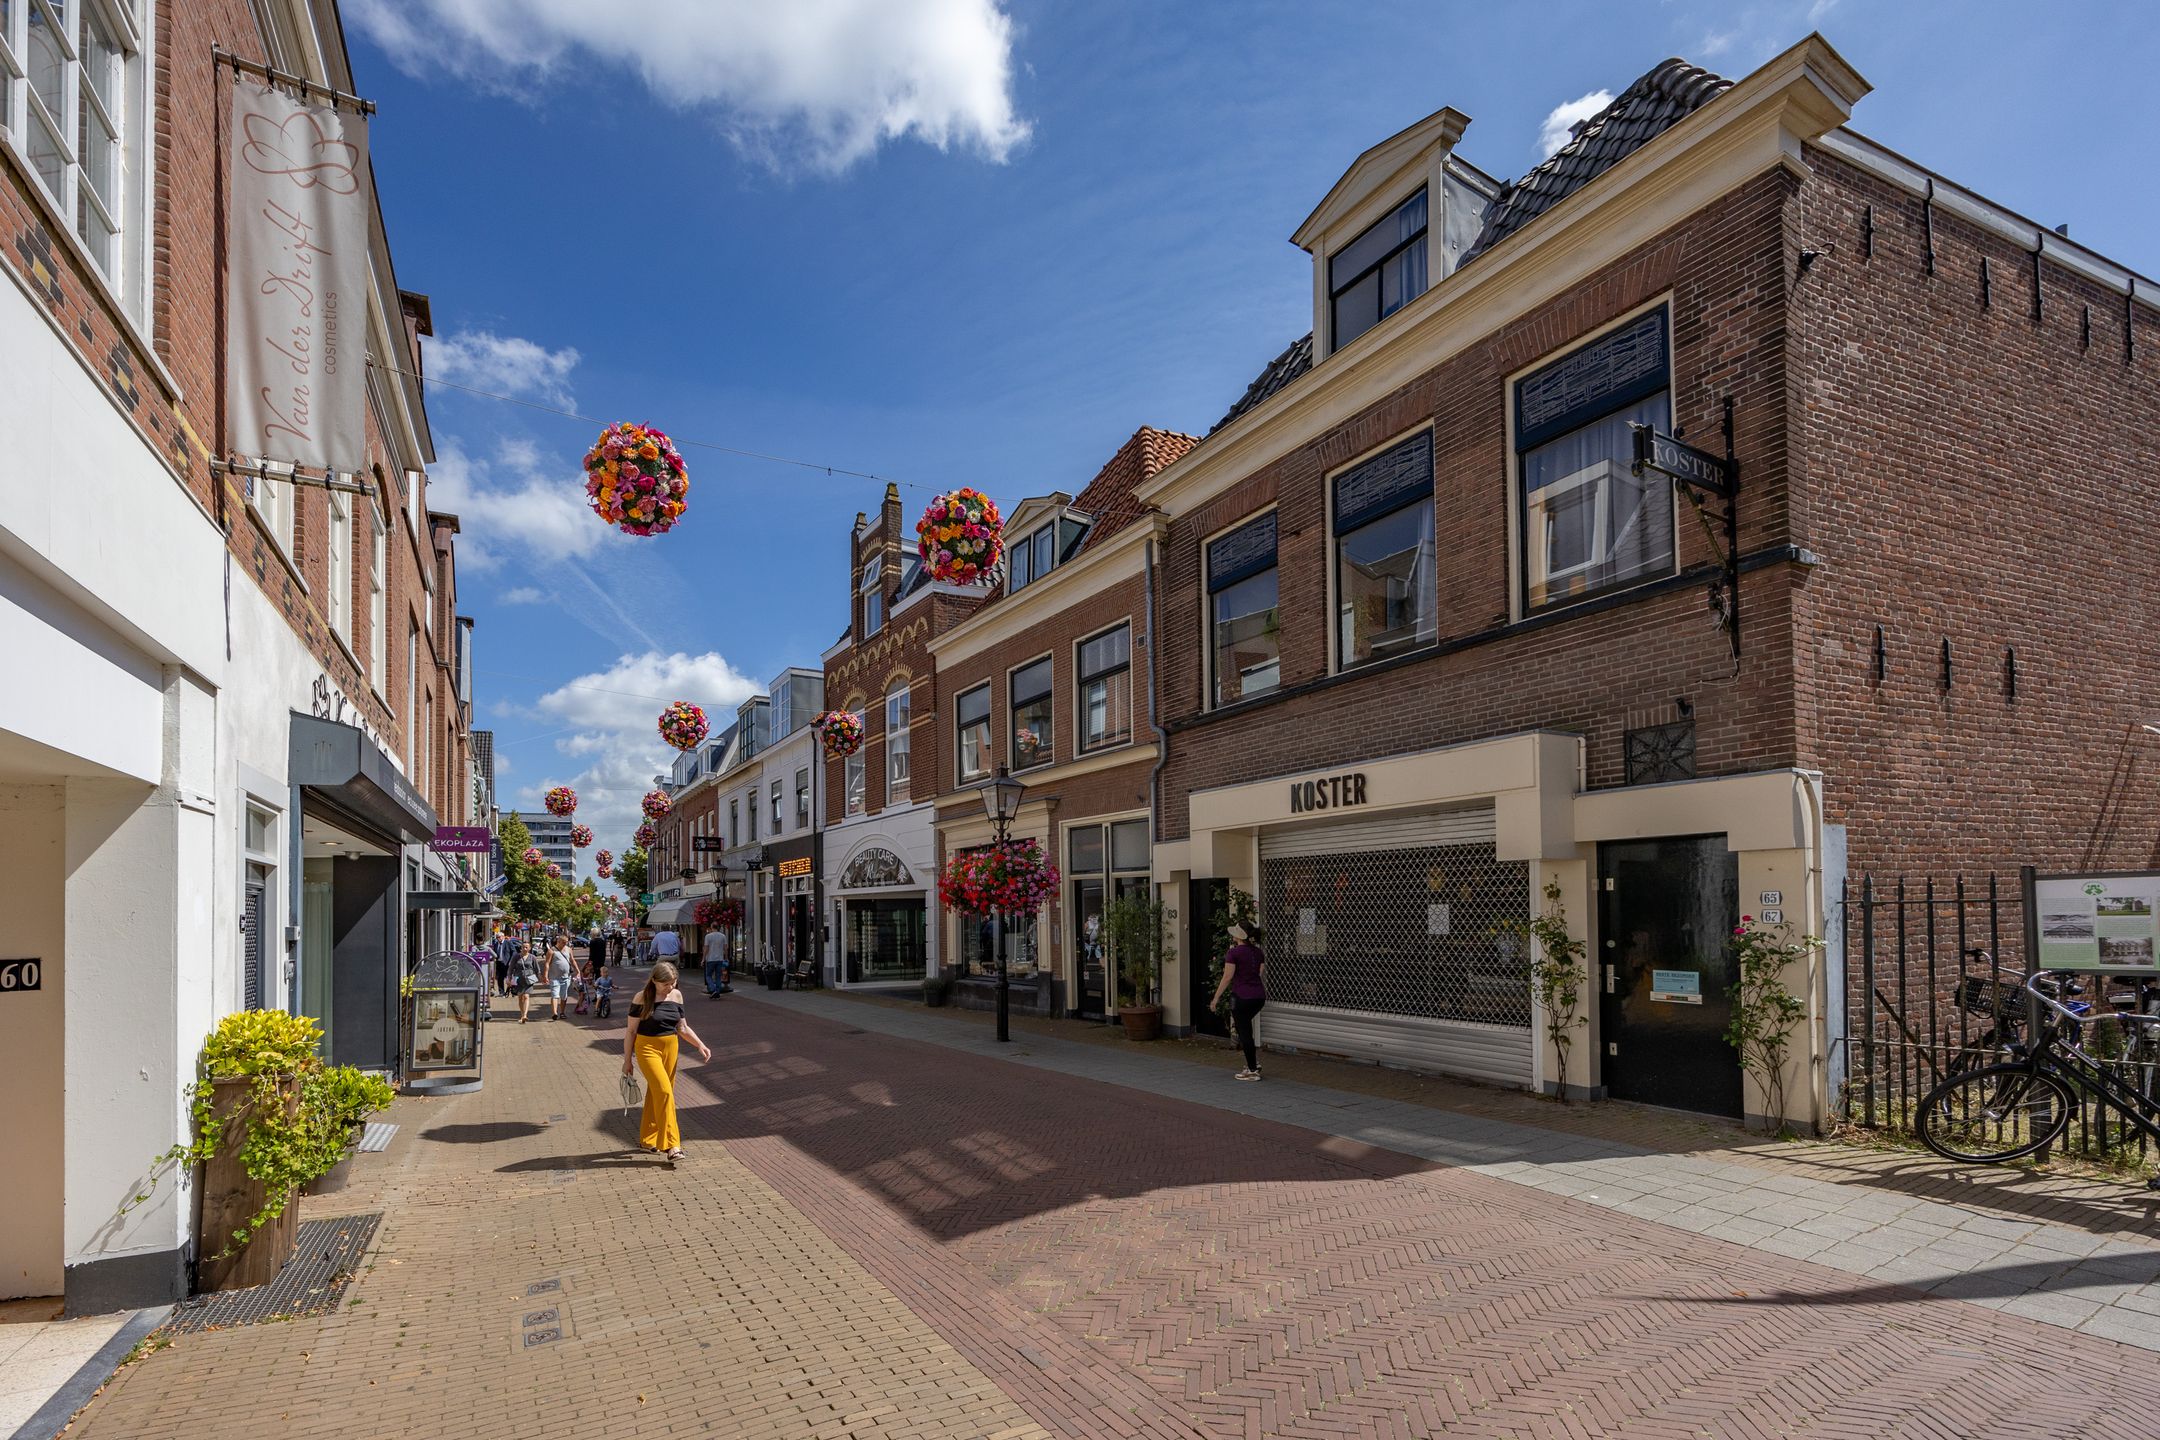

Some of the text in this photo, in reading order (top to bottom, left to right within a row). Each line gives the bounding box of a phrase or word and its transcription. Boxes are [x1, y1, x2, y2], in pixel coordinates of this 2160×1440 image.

[261, 199, 332, 442] Van der Drift
[320, 291, 337, 375] cosmetics
[1651, 440, 1725, 487] KOSTER
[1291, 773, 1367, 813] KOSTER
[855, 849, 895, 867] BEAUTY CARE
[1764, 893, 1777, 904] 65
[1168, 909, 1178, 919] 63
[1765, 911, 1778, 922] 67
[1, 962, 39, 989] 60
